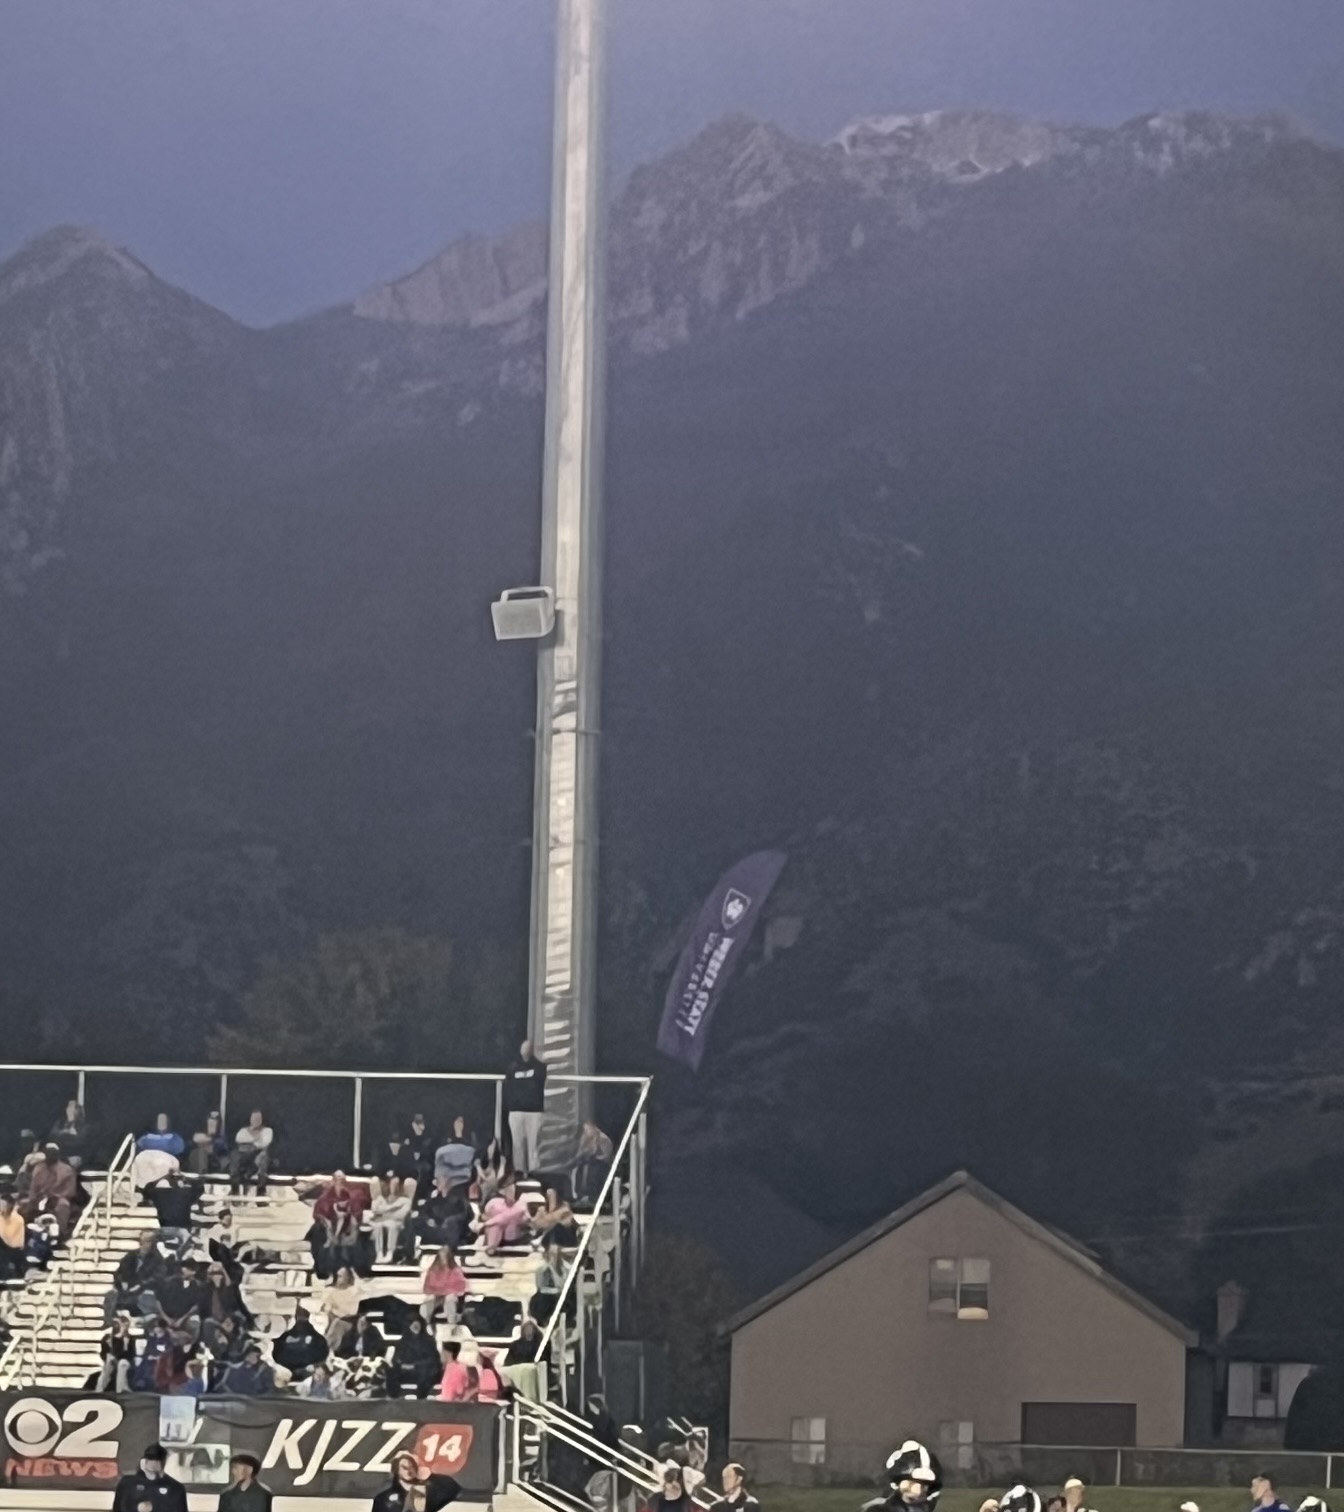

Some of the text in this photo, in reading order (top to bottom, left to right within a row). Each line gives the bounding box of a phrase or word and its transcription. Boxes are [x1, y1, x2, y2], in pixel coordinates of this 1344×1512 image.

[53, 1399, 123, 1458] 2
[261, 1418, 462, 1486] KJZZ 14
[4, 1458, 119, 1478] NEWS
